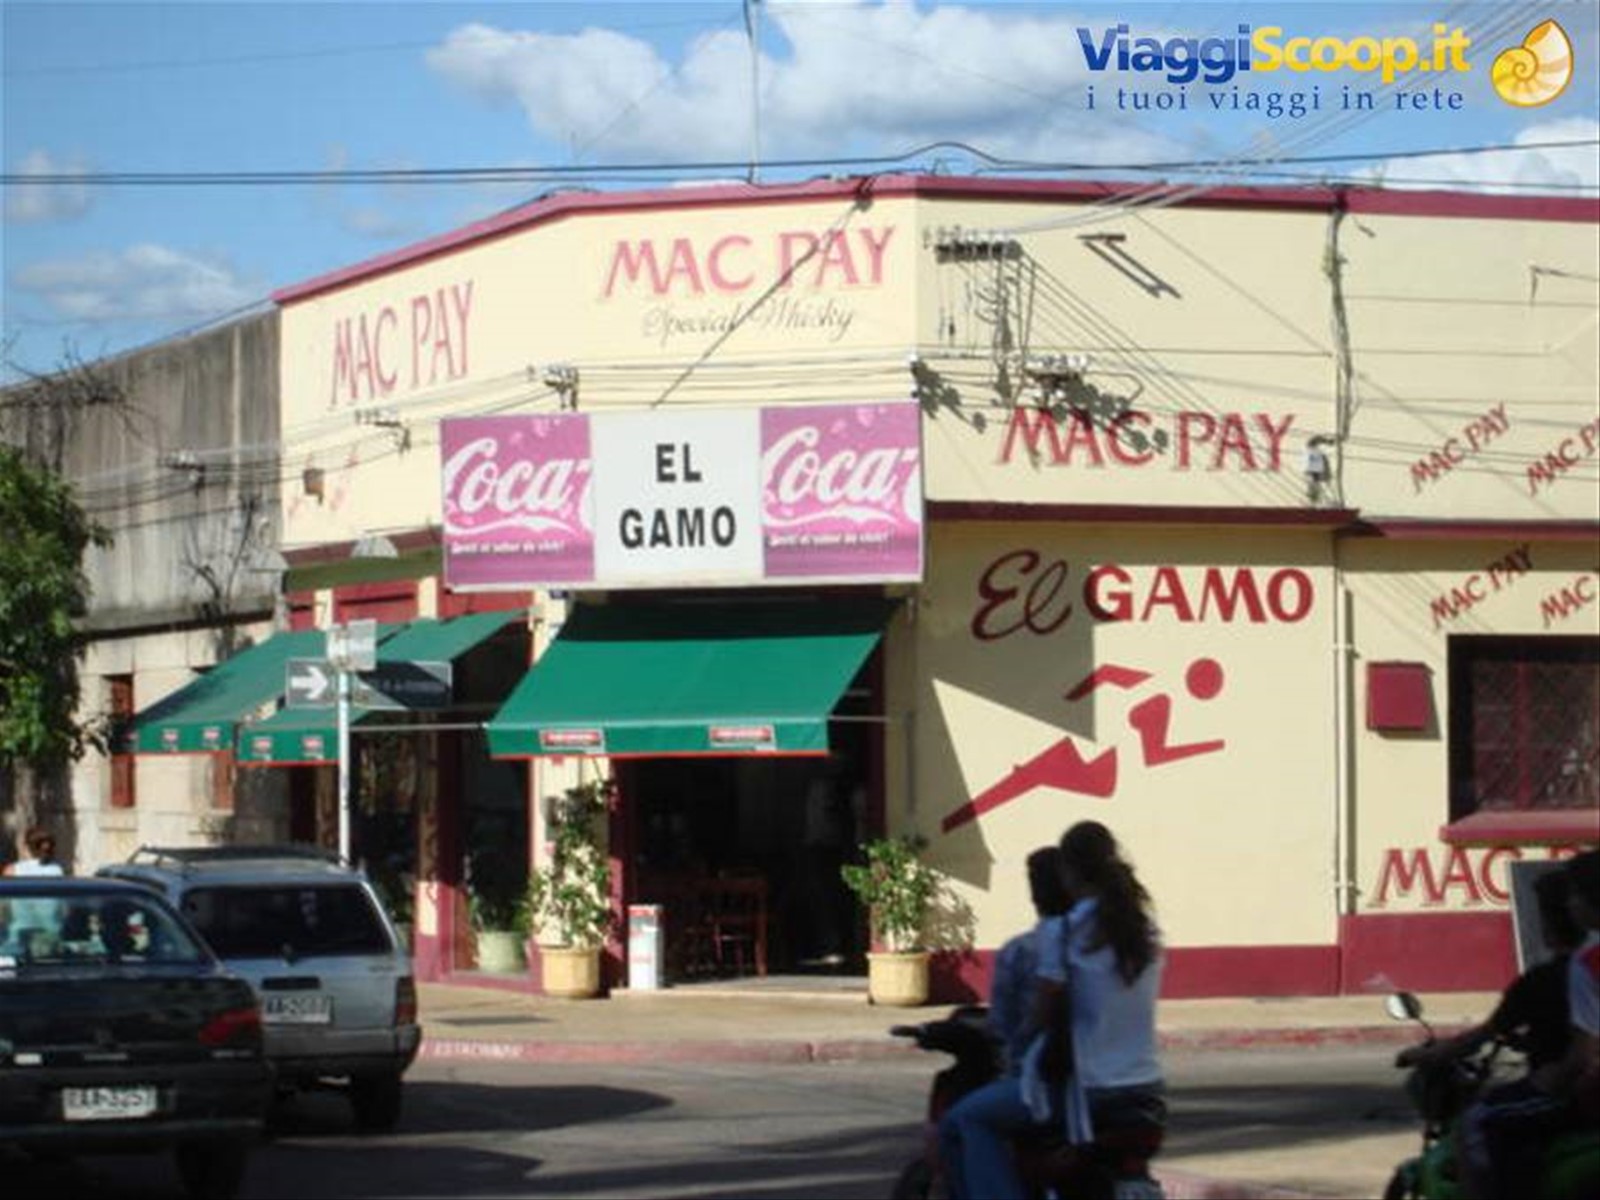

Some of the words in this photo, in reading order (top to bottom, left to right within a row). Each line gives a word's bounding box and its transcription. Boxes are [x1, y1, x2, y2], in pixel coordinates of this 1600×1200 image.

[605, 233, 755, 298] MAC
[777, 226, 896, 290] PAY
[327, 306, 399, 411] MAC
[410, 279, 474, 390] PAY
[640, 301, 745, 347] Special
[749, 296, 855, 342] Whisky
[655, 443, 702, 483] EL
[995, 405, 1154, 468] MAC
[1172, 410, 1296, 471] PAY
[1409, 437, 1466, 495] MAC
[1463, 400, 1511, 455] PAY
[1526, 437, 1581, 498] MAC
[619, 506, 737, 550] GAMO
[970, 549, 1073, 641] El
[1083, 565, 1314, 623] GAMO
[1429, 574, 1487, 631] MAC
[1486, 542, 1534, 591] PAY
[1539, 575, 1597, 630] MAC
[1366, 846, 1521, 908] MAC
